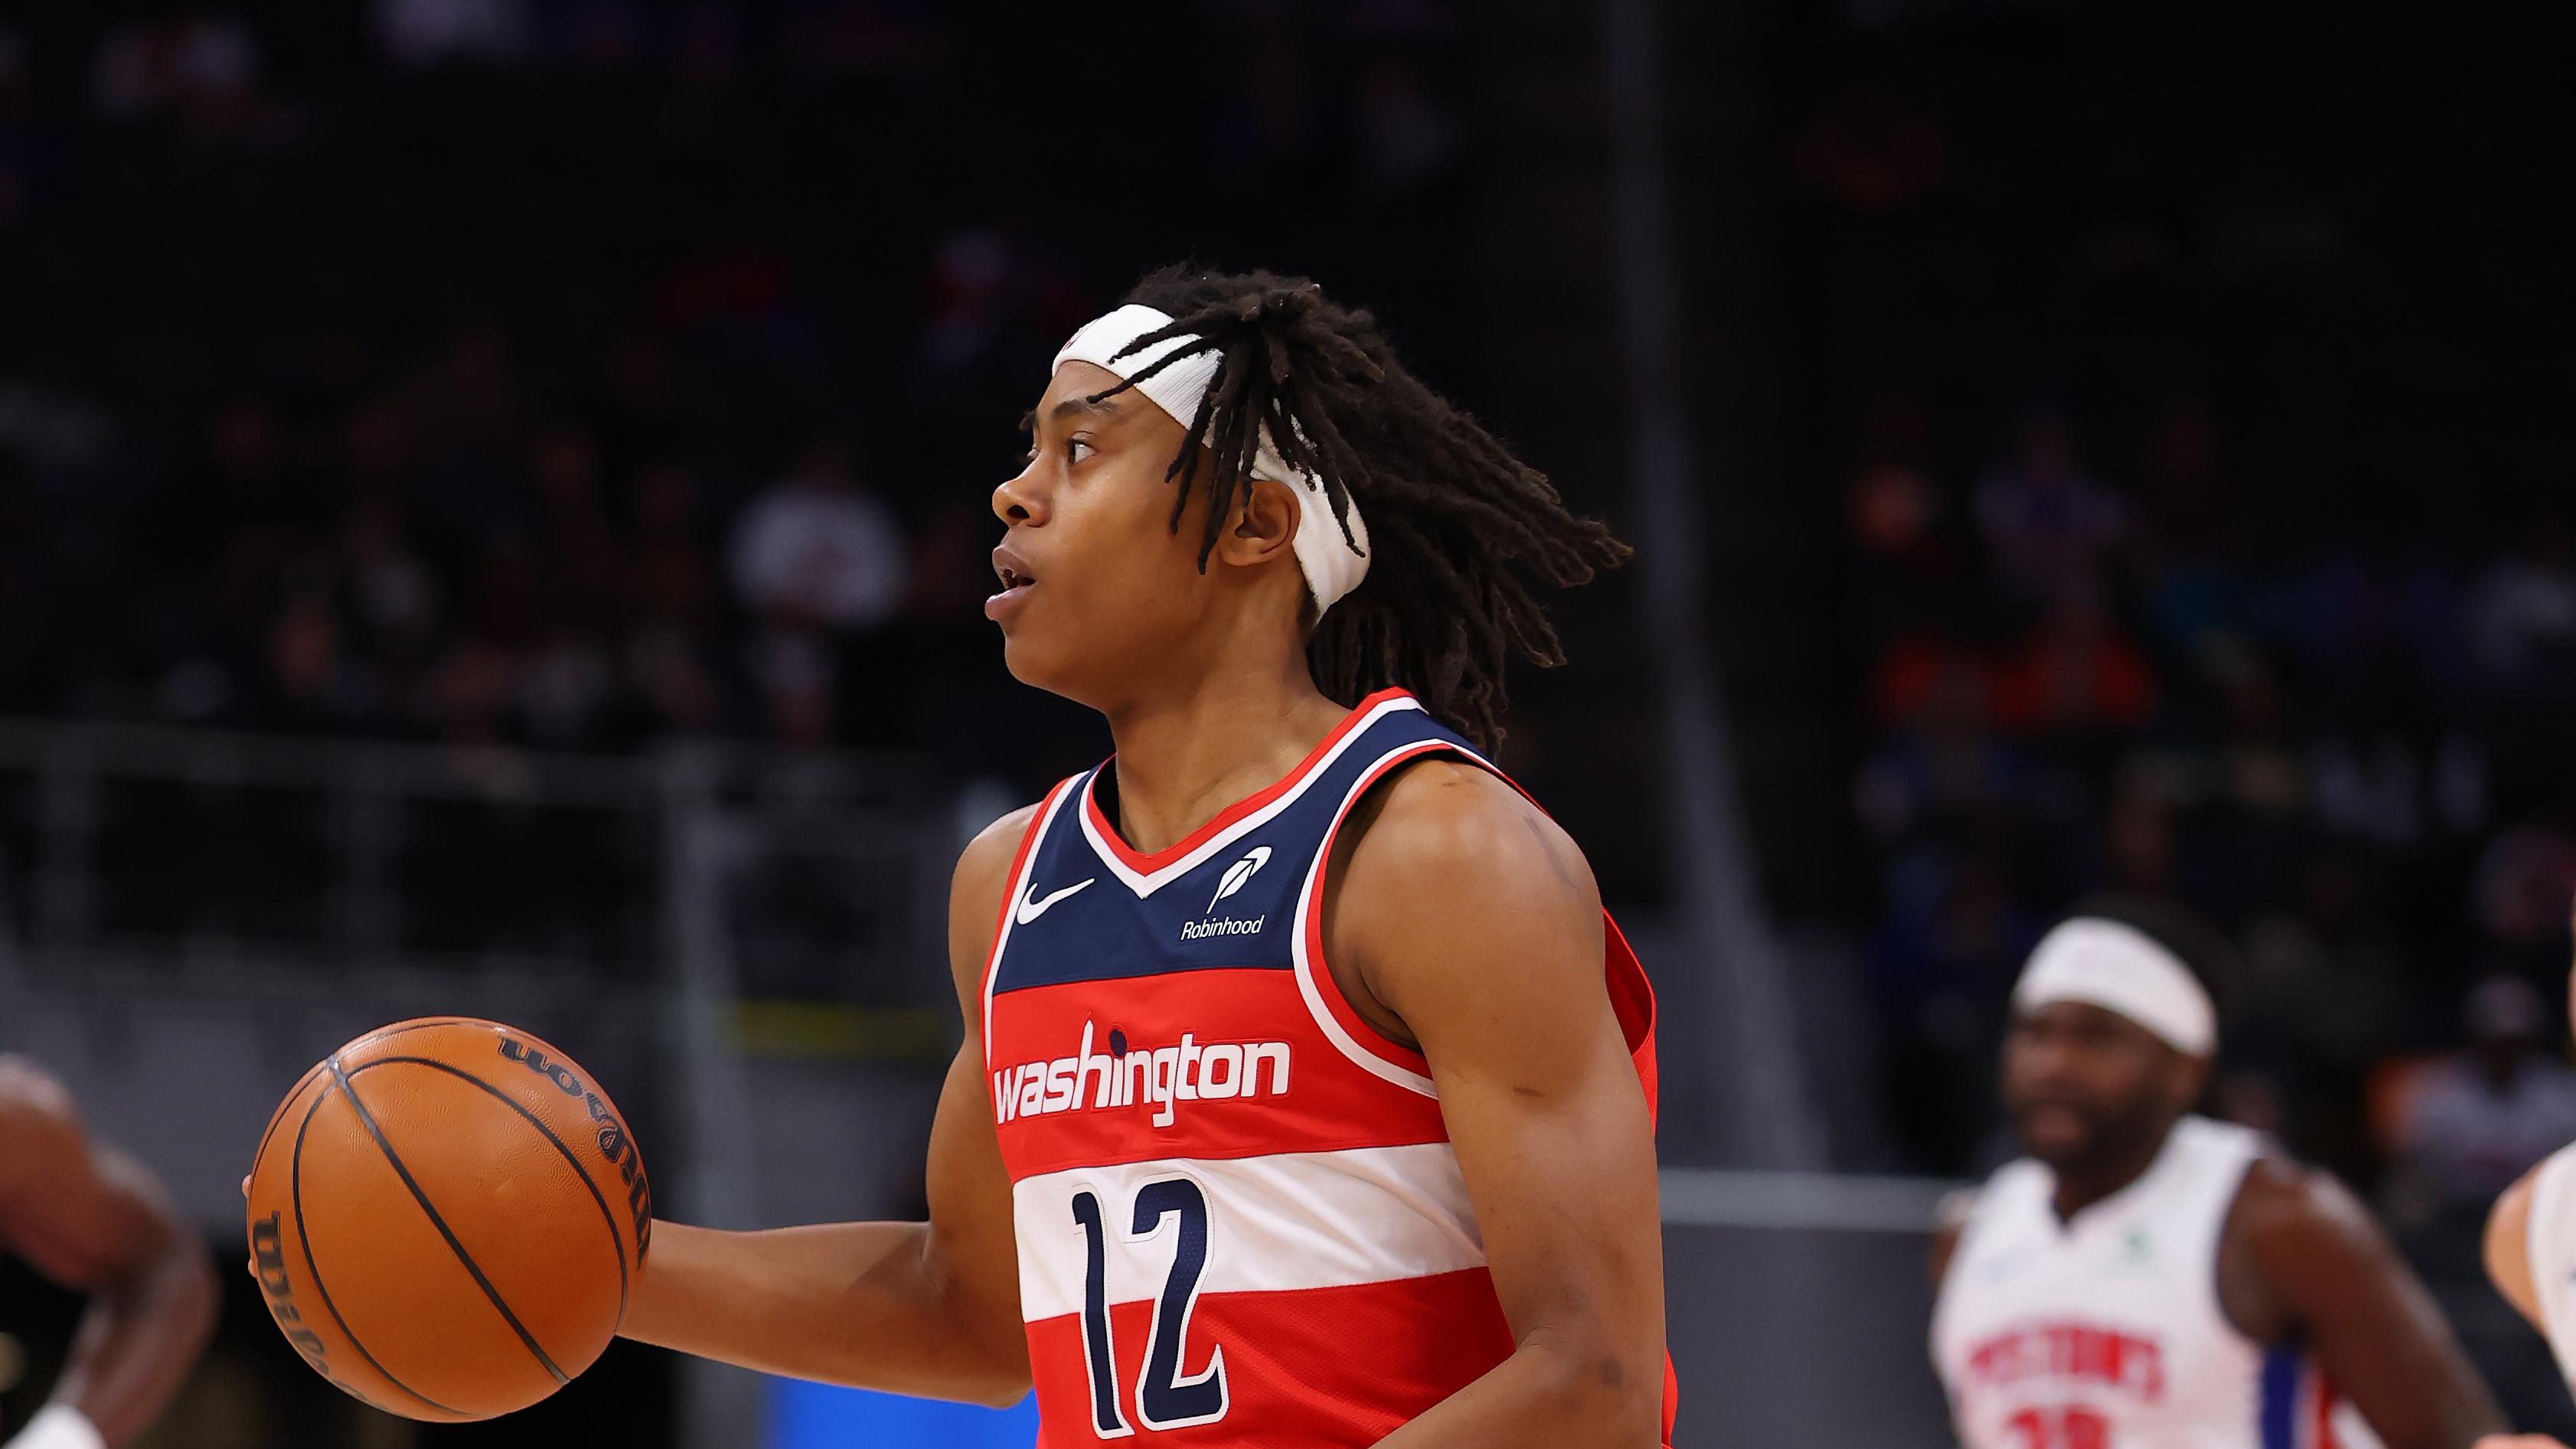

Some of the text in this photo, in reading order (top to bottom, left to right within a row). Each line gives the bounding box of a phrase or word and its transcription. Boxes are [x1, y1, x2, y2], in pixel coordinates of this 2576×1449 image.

[1180, 915, 1265, 941] Robinhood
[993, 1019, 1291, 1128] washington
[1072, 1174, 1230, 1440] 12
